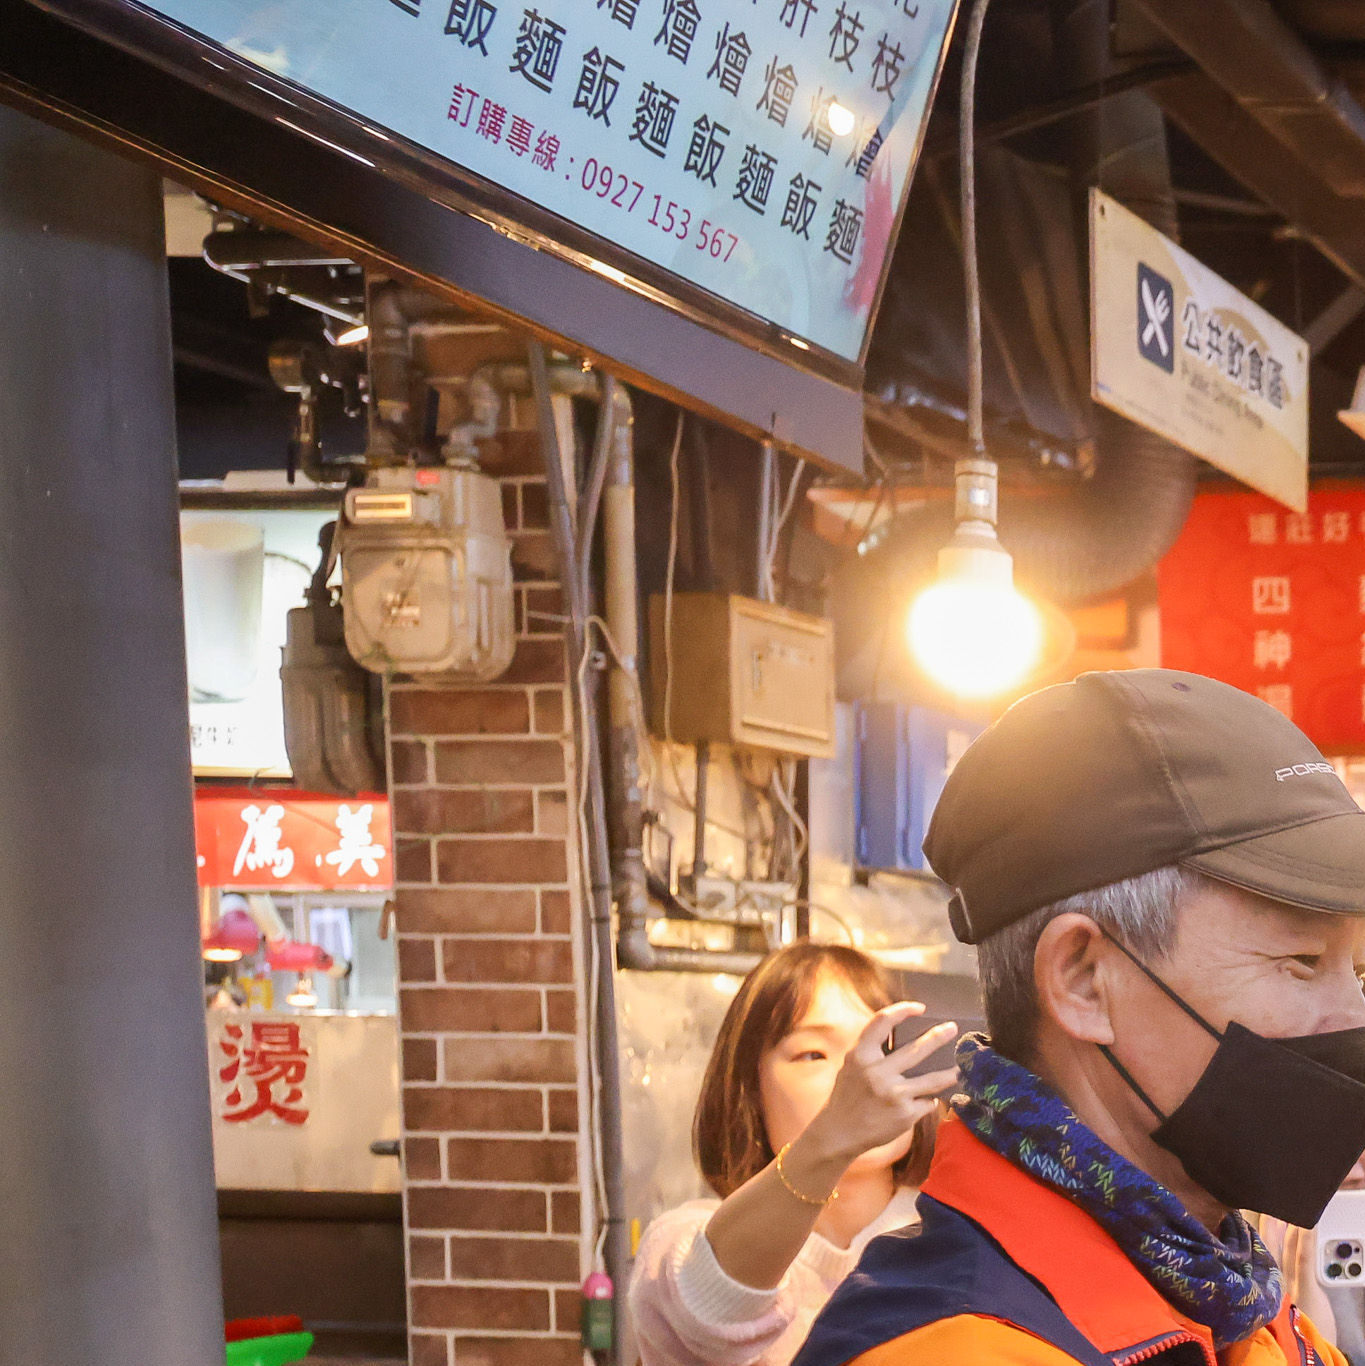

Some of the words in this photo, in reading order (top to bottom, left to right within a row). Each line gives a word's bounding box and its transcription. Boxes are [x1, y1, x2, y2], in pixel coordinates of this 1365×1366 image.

[648, 194, 692, 241] 153
[695, 219, 739, 263] 567
[219, 1022, 309, 1125] 燙
